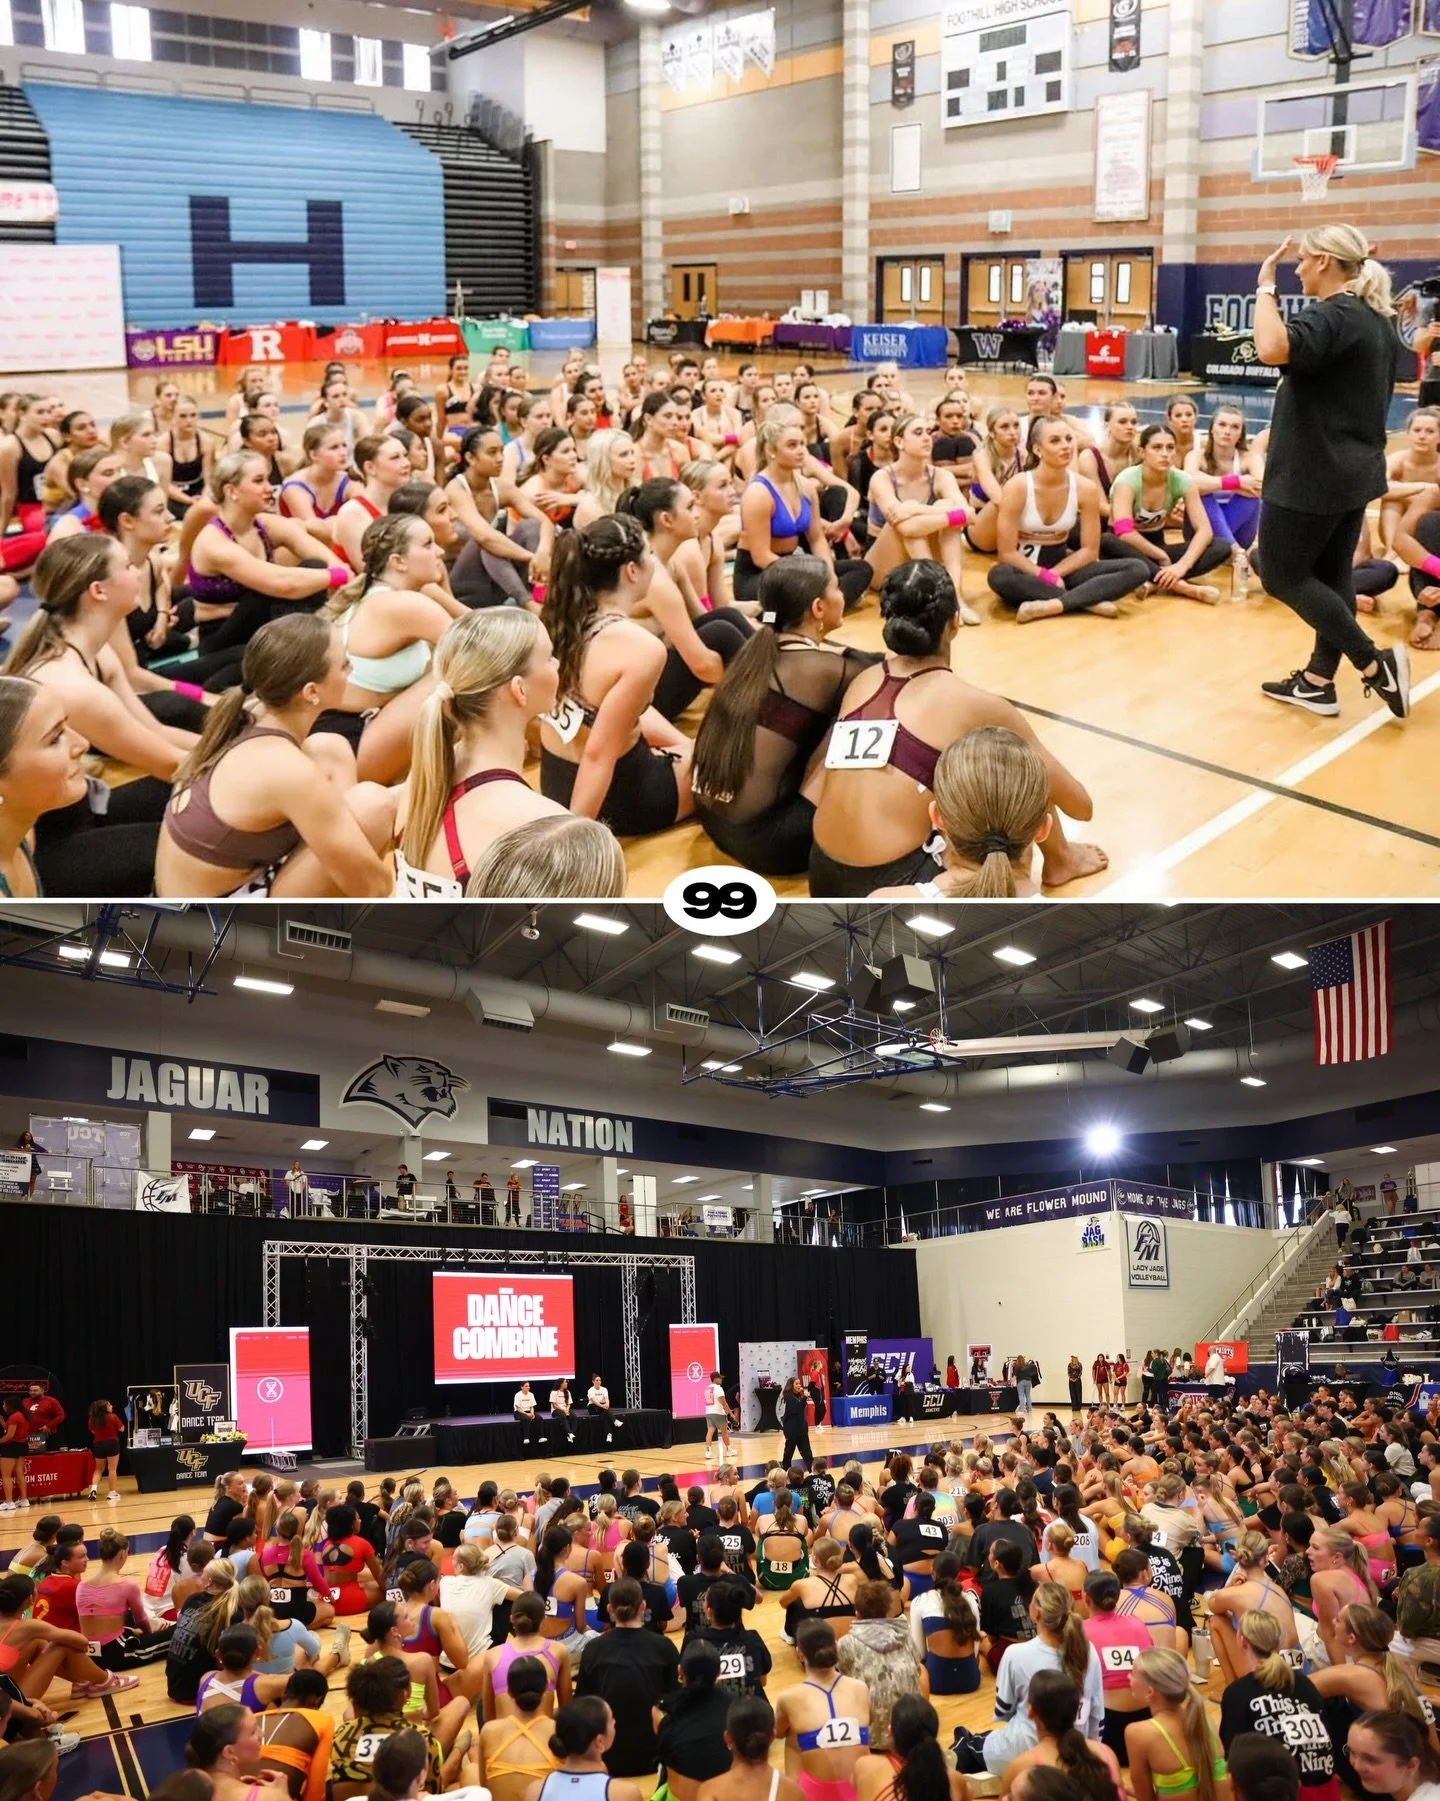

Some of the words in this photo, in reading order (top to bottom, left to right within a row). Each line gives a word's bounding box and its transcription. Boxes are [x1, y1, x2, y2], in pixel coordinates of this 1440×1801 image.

[946, 8, 991, 26] FOOTHILL
[994, 2, 1018, 17] HIGH
[188, 196, 346, 308] H
[156, 335, 214, 354] LSU
[250, 329, 285, 361] R
[863, 333, 907, 347] KEISER
[971, 333, 1004, 360] W
[863, 346, 908, 358] UNIVERSITY
[1206, 364, 1245, 375] COLORADO
[844, 727, 884, 760] 12
[107, 1056, 270, 1115] JAGUAR
[527, 1108, 634, 1153] NATION
[985, 1208, 1001, 1220] WE
[1005, 1205, 1023, 1217] ARE
[1027, 1198, 1067, 1213] FLOWER
[1072, 1190, 1107, 1206] MOUND
[1146, 1194, 1155, 1206] OF
[1172, 1198, 1187, 1210] JAGS
[1083, 1225, 1101, 1238] JAG
[1081, 1234, 1105, 1248] BASH
[1132, 1264, 1148, 1272] LADY
[1131, 1273, 1167, 1281] VOLLEYBALL
[467, 1293, 545, 1327] DANCE
[453, 1326, 559, 1360] COMBINE
[845, 1335, 867, 1345] MEMPHIS
[183, 1380, 222, 1411] UCF
[922, 1394, 945, 1407] GCU
[850, 1404, 888, 1419] Memphis
[181, 1416, 205, 1428] DANCE
[175, 1447, 208, 1471] UCF
[37, 1472, 58, 1482] STATE
[176, 1472, 194, 1480] DANCE
[194, 1470, 208, 1478] TEAM
[924, 1526, 938, 1536] 43
[775, 1562, 788, 1572] 18
[273, 1590, 286, 1601] 30
[1111, 1650, 1134, 1666] 94
[1249, 1693, 1296, 1717] This
[1295, 1698, 1311, 1715] is
[826, 1722, 852, 1743] 12
[1286, 1718, 1325, 1740] 301
[1300, 1751, 1334, 1775] Nine
